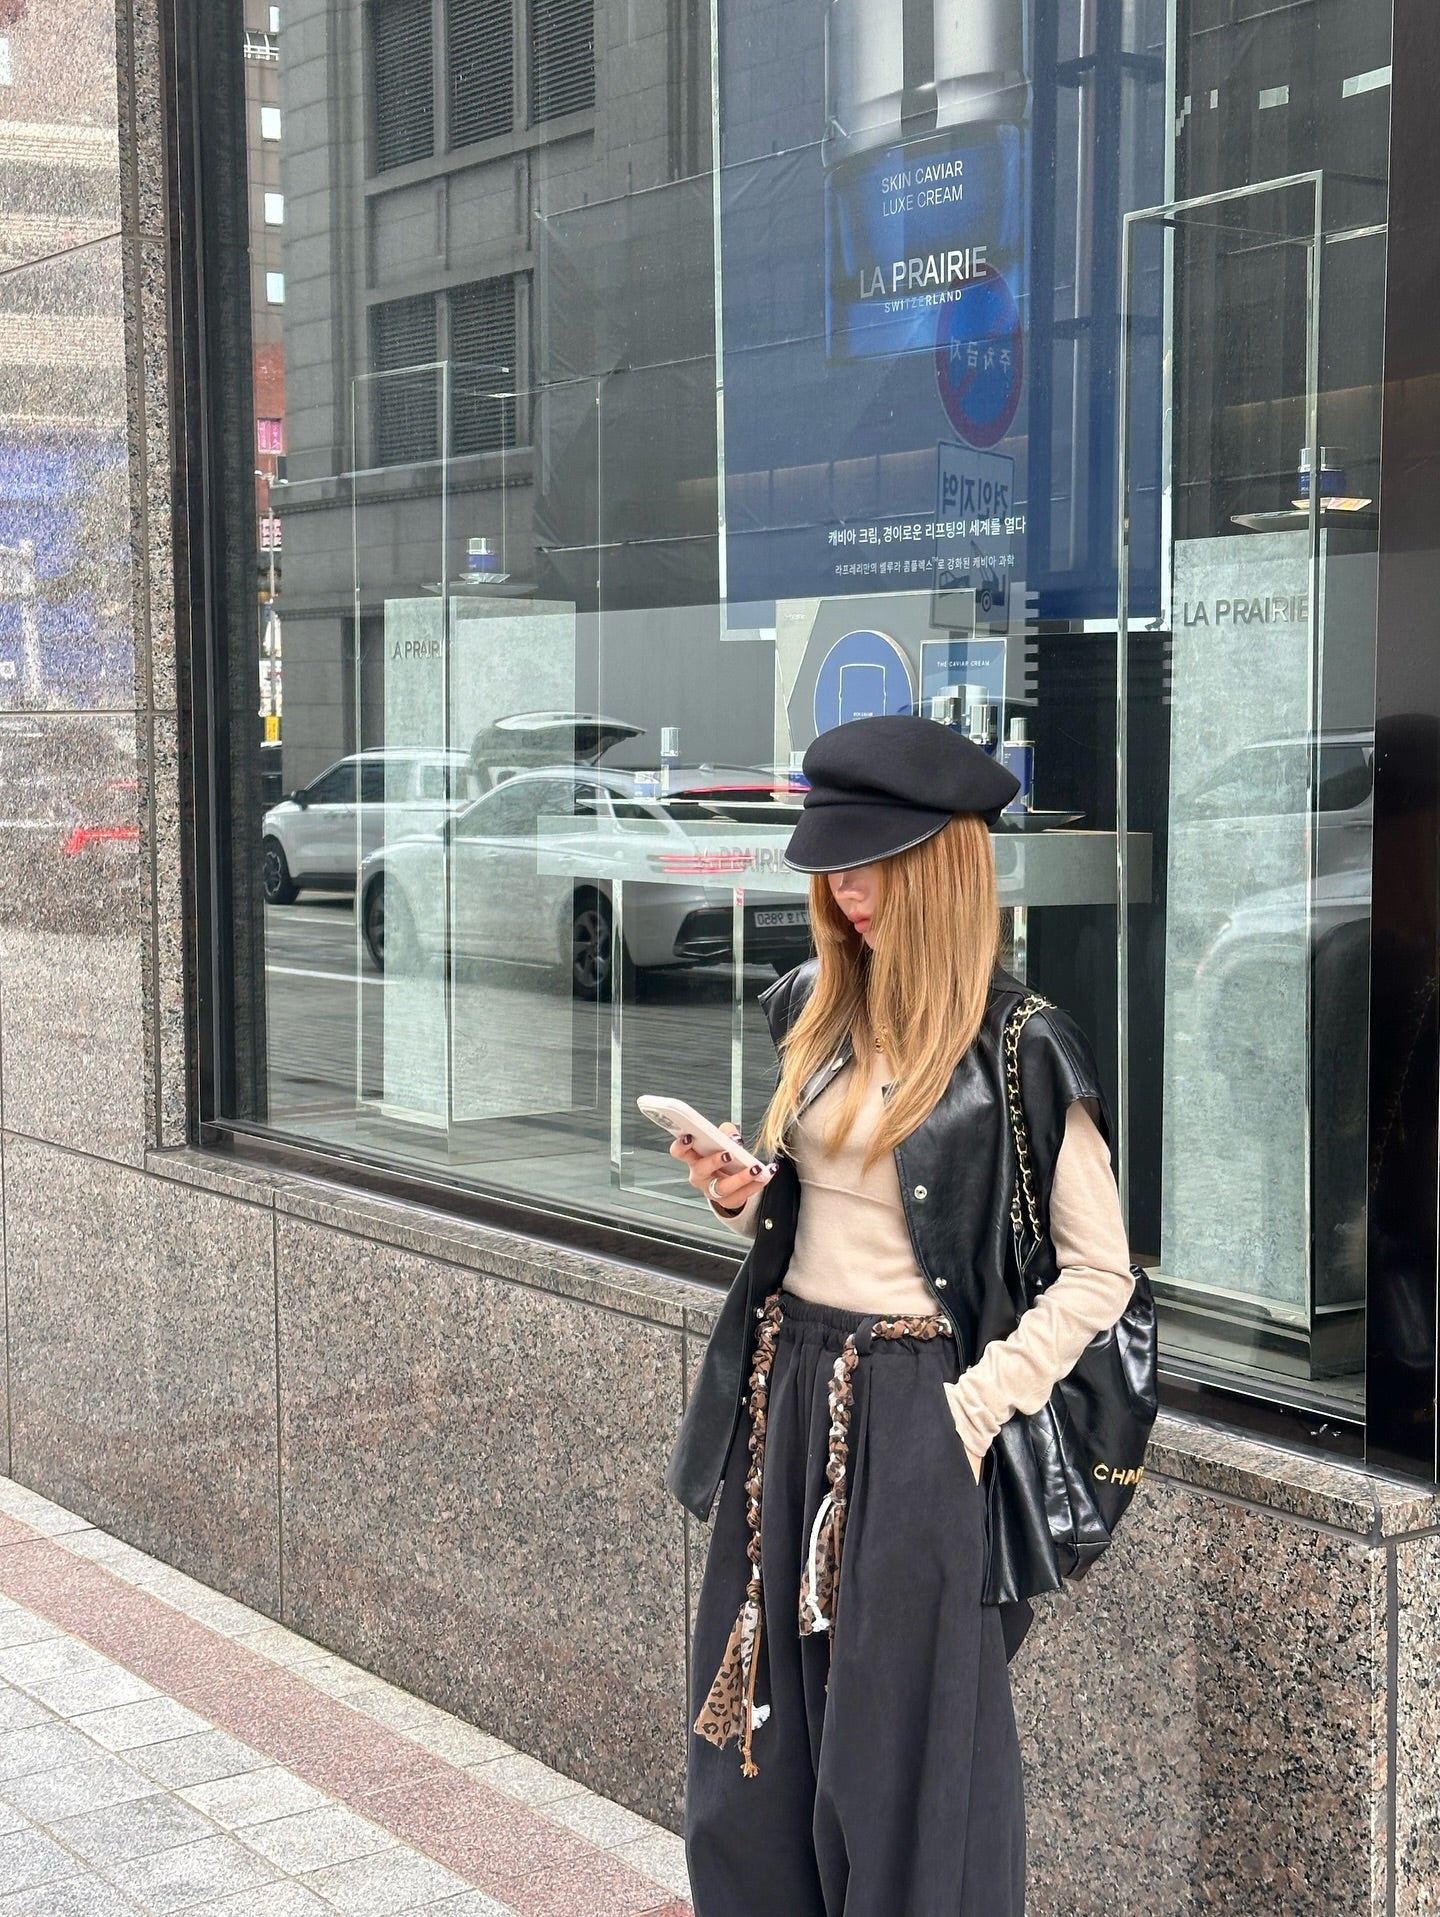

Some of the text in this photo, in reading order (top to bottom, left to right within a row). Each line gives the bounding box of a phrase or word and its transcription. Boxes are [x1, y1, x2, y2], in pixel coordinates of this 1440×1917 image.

[881, 160, 963, 194] SKIN CAVIAR
[882, 184, 963, 217] LUXE CREAM
[860, 245, 987, 299] LA PRAIRIE
[884, 290, 962, 313] SWITZERLAND
[828, 515, 1027, 546] 캐비아 크림, 경이로운 리프팅의 세계를 열다
[972, 555, 996, 569] 캐비아
[1183, 600, 1210, 627] LA
